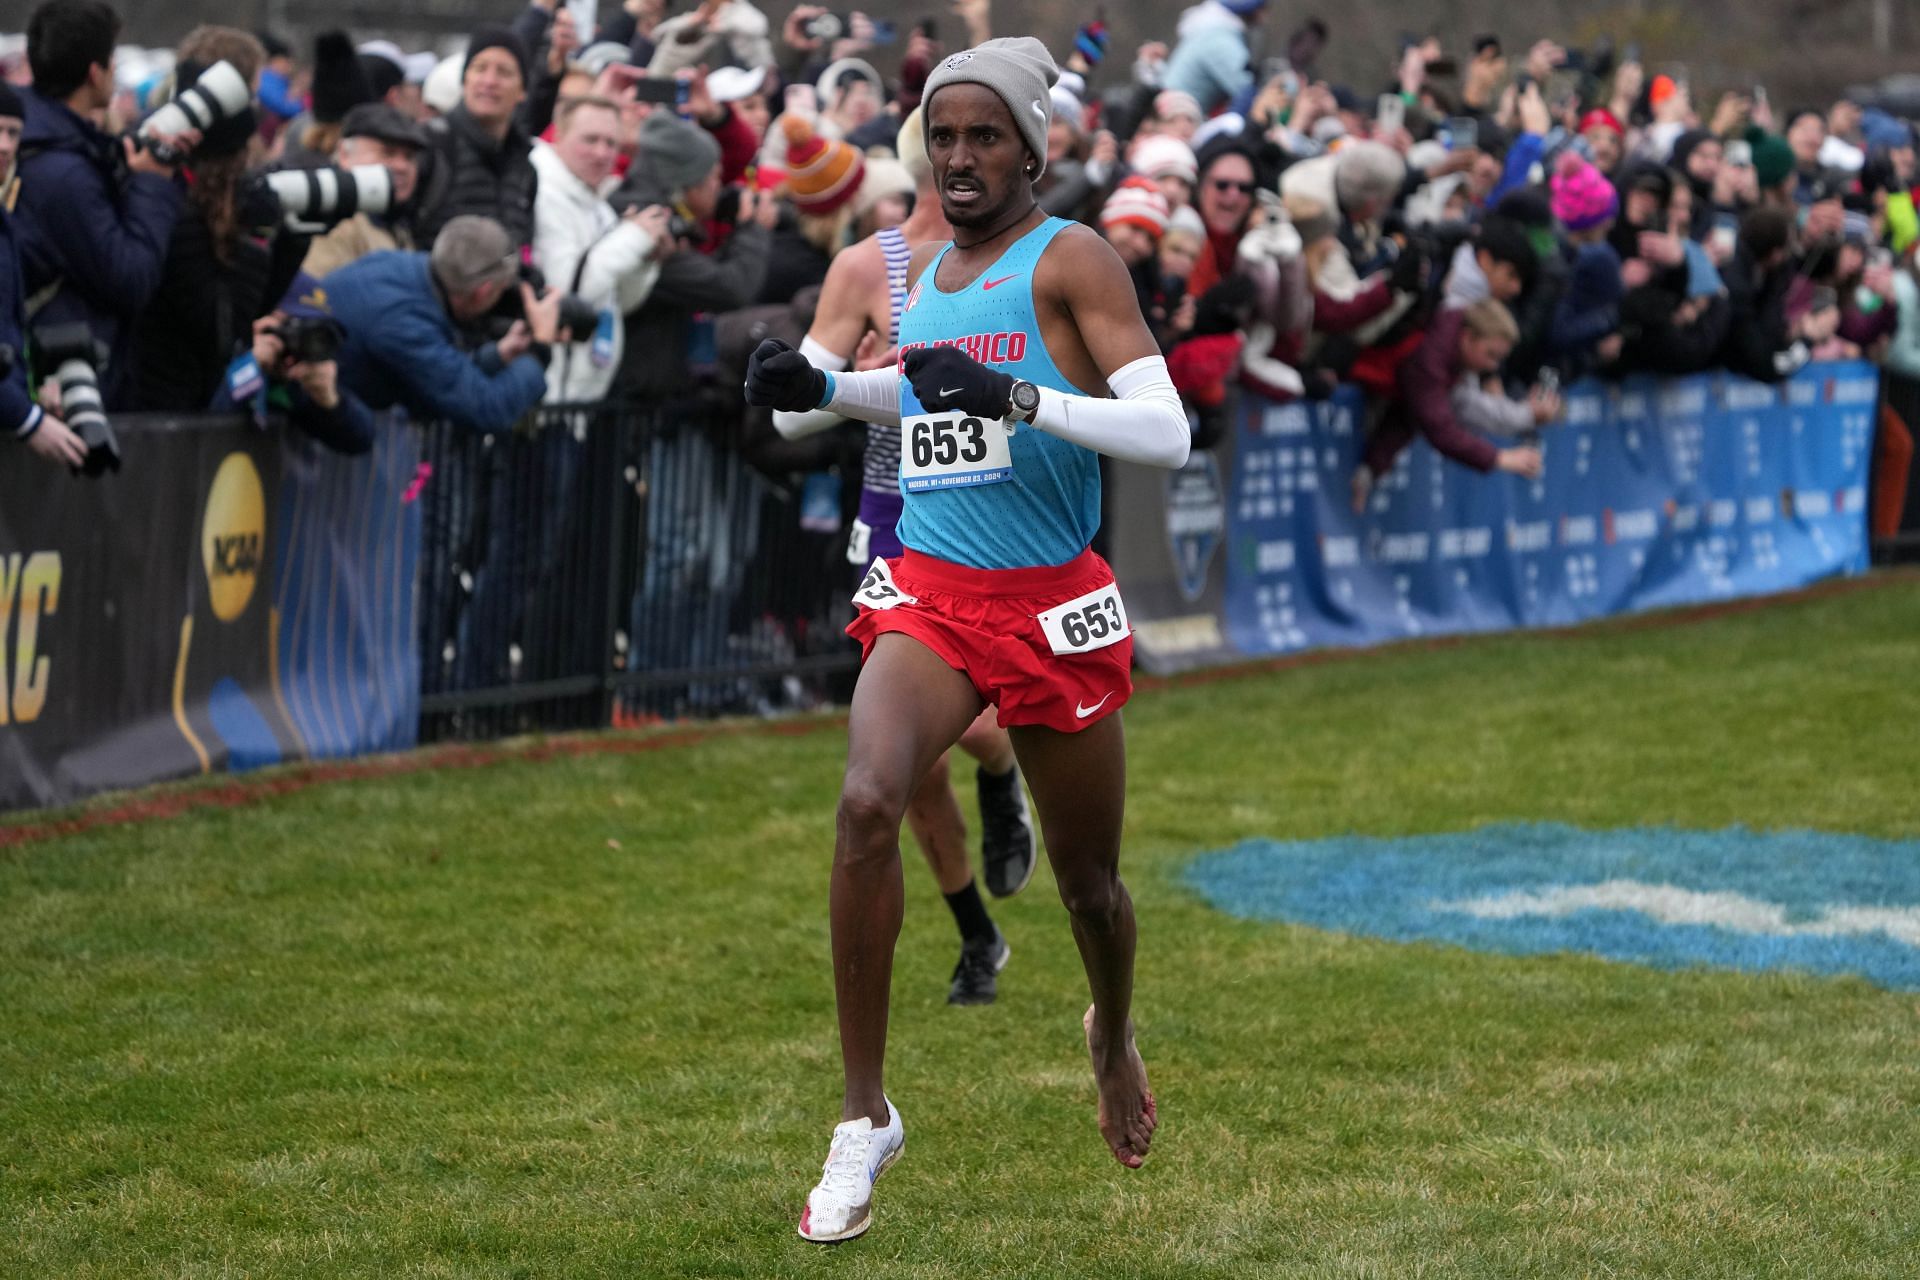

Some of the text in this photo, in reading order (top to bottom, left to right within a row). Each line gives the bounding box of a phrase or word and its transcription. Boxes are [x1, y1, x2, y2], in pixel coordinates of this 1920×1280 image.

[933, 332, 1028, 365] XICO
[911, 417, 988, 468] 653
[941, 476, 972, 486] NOVEMBER
[984, 472, 1001, 481] 2024
[212, 533, 259, 576] NCAA
[857, 566, 898, 600] 53
[1061, 596, 1122, 647] 653
